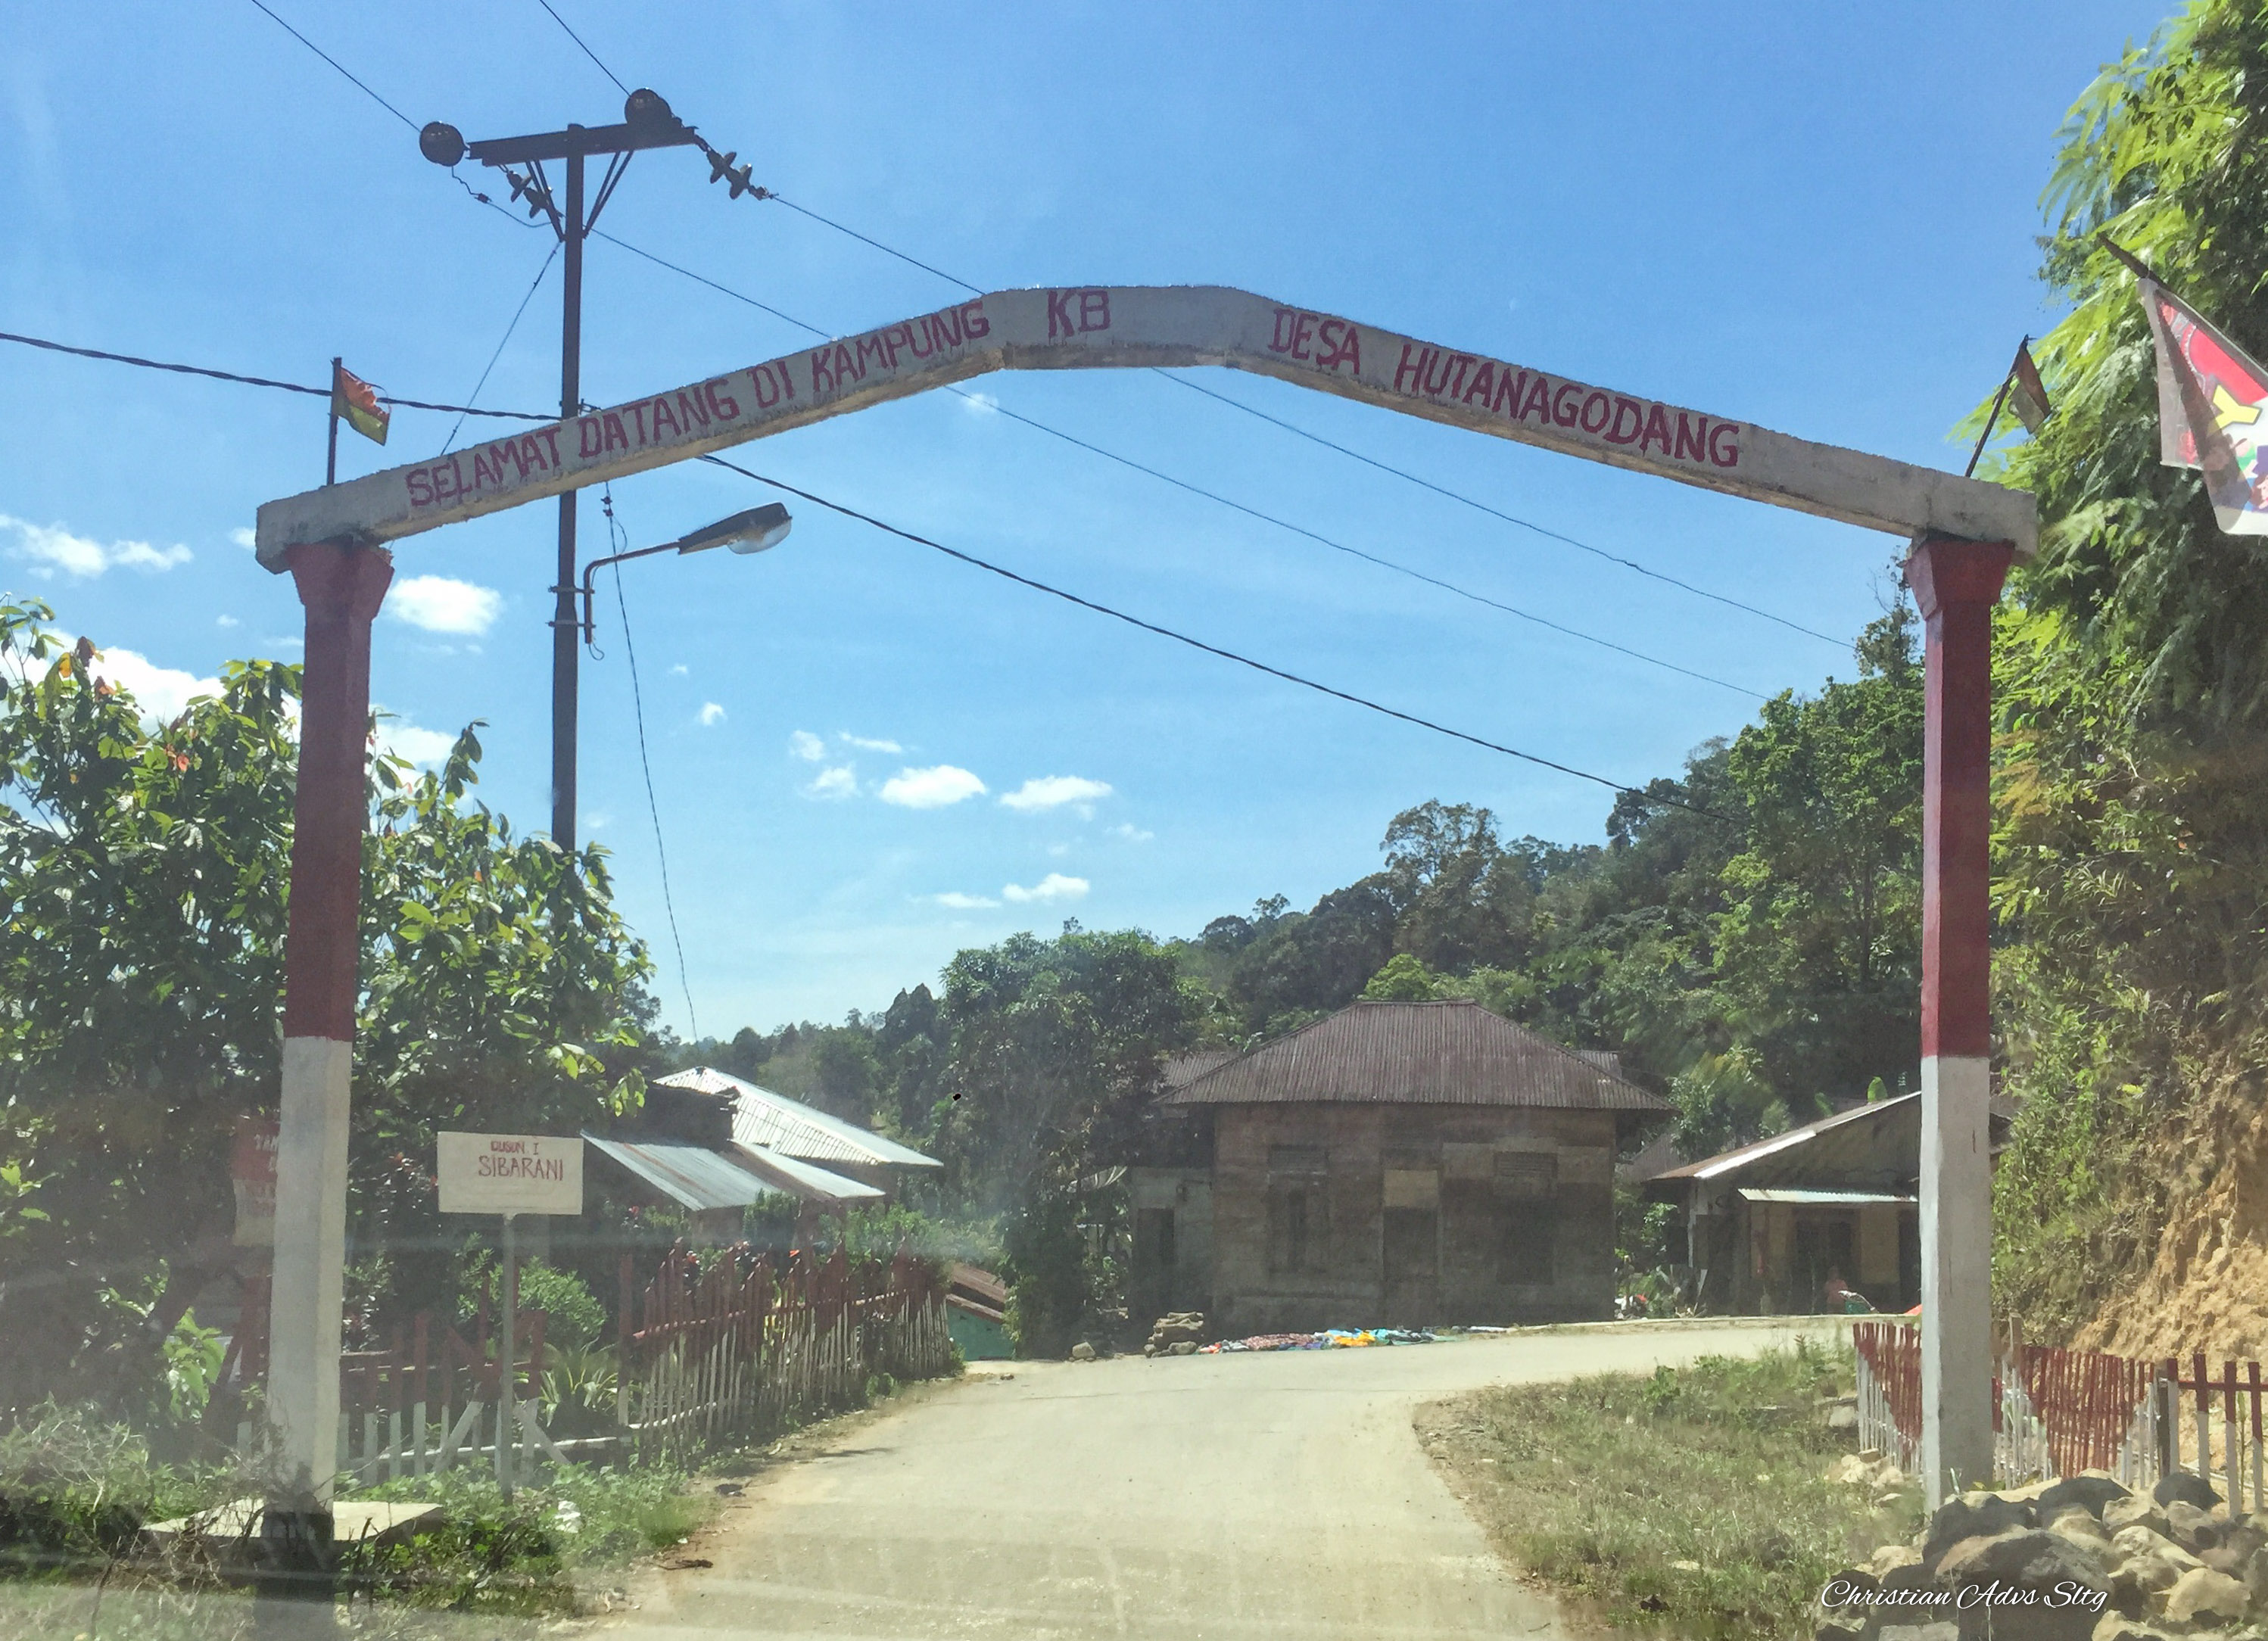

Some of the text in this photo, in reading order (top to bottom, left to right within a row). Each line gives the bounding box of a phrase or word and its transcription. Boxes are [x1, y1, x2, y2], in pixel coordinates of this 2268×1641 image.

[405, 288, 1740, 506] SELAMAT DATANG DI KAMPUNG KB DESA HUTANAGODANG
[478, 1155, 563, 1181] SIBARANI
